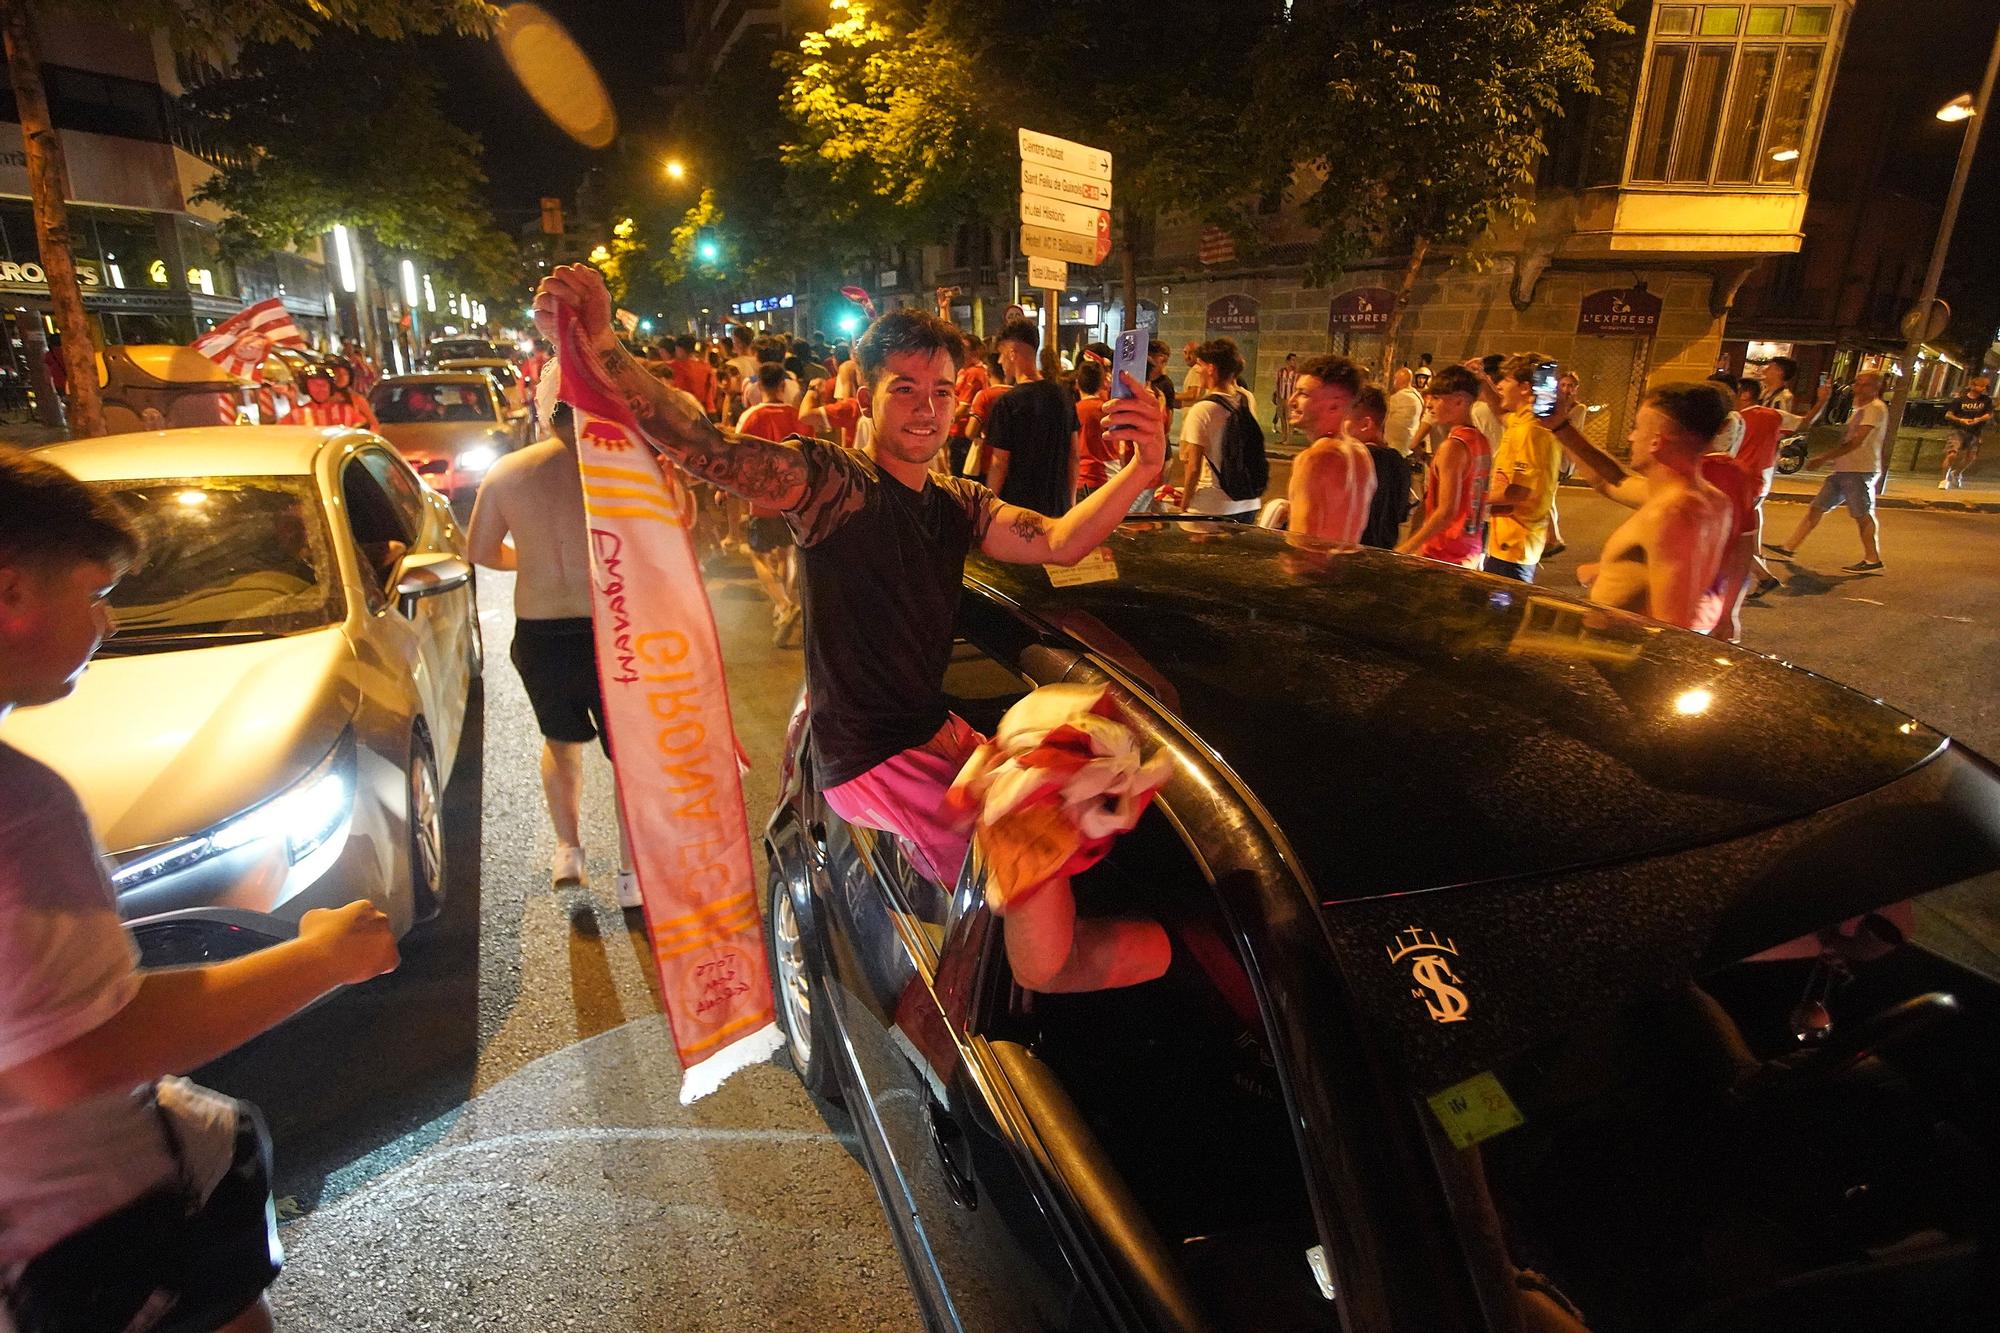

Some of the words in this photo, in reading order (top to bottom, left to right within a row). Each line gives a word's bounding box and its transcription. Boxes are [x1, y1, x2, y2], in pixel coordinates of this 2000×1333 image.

[1022, 138, 1045, 156] Centre
[1023, 170, 1038, 185] Sant
[1024, 203, 1042, 217] Hotel
[1333, 313, 1389, 323] L'EXPRES
[1583, 314, 1655, 324] L'EXPRESS
